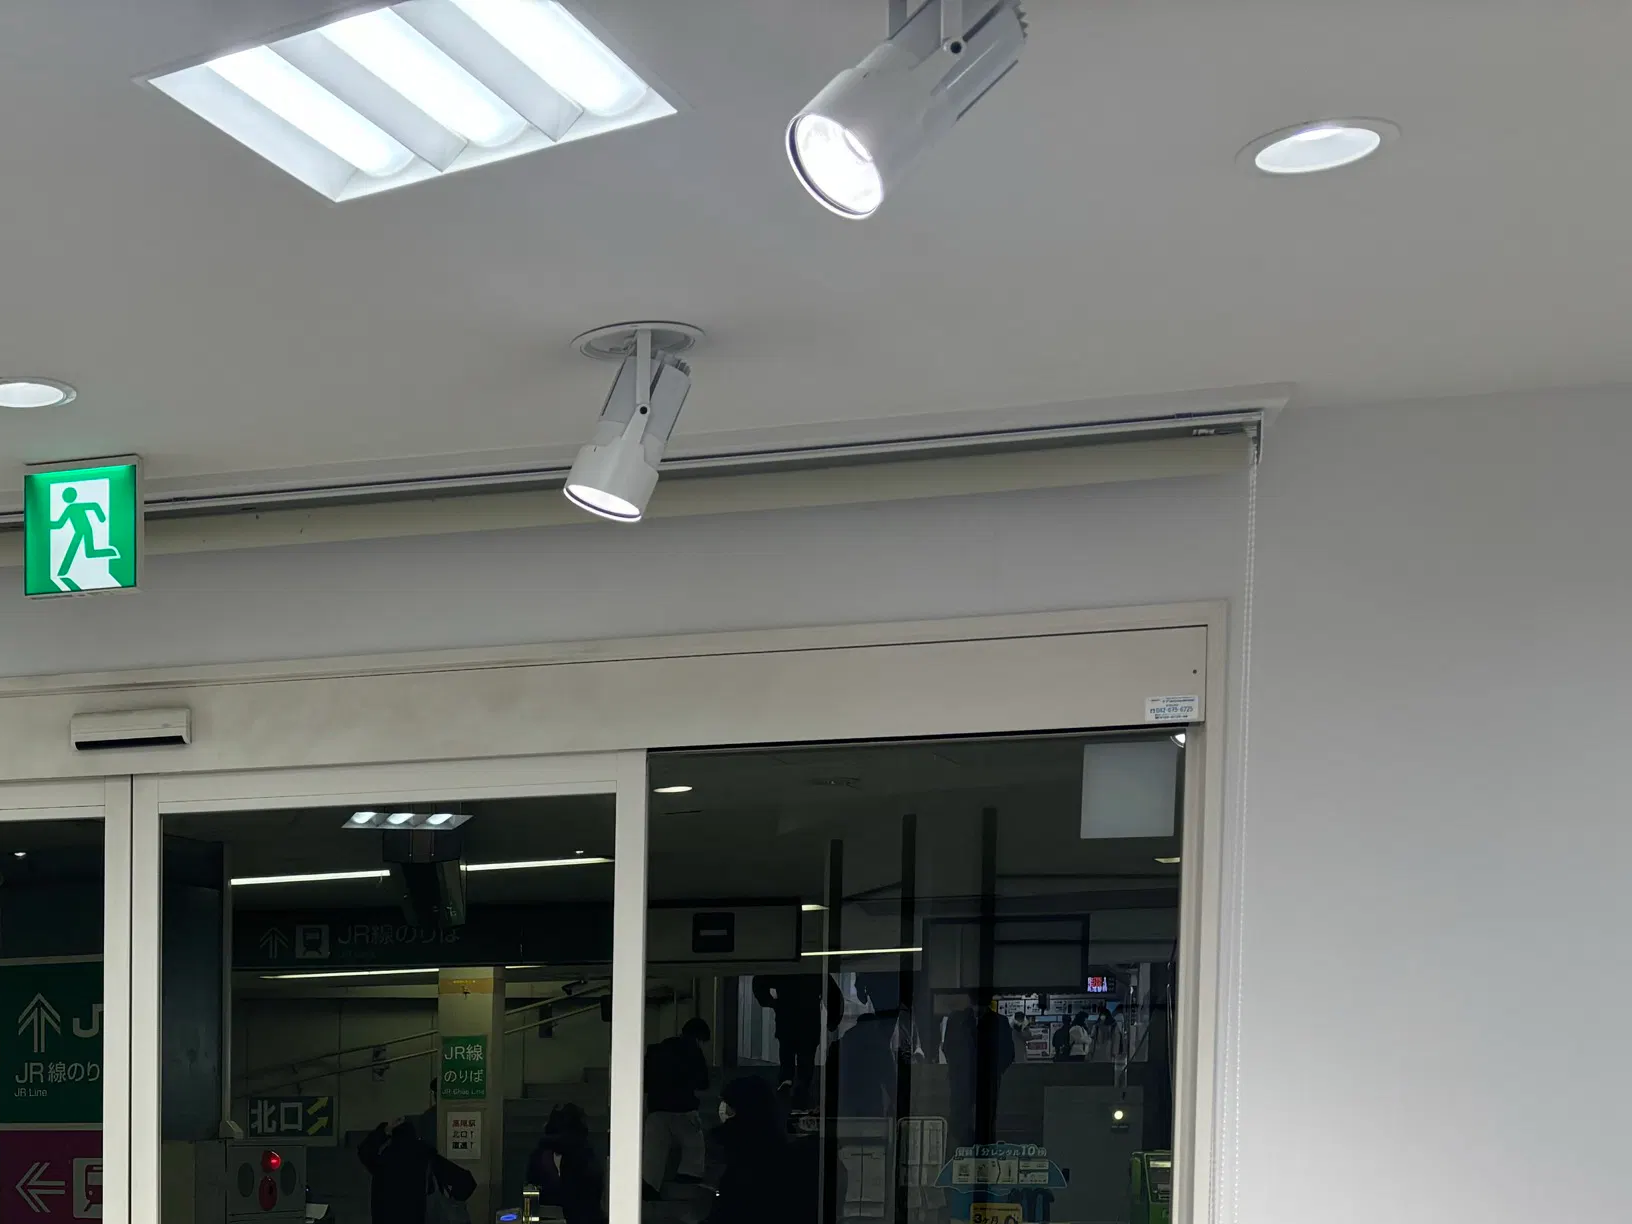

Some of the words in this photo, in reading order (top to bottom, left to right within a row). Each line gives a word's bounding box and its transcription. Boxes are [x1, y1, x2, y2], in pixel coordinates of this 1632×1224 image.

[444, 1044, 484, 1062] JR線
[444, 1070, 484, 1083] のりば
[14, 1088, 26, 1097] JR
[29, 1088, 48, 1097] Line
[251, 1100, 303, 1133] 北口
